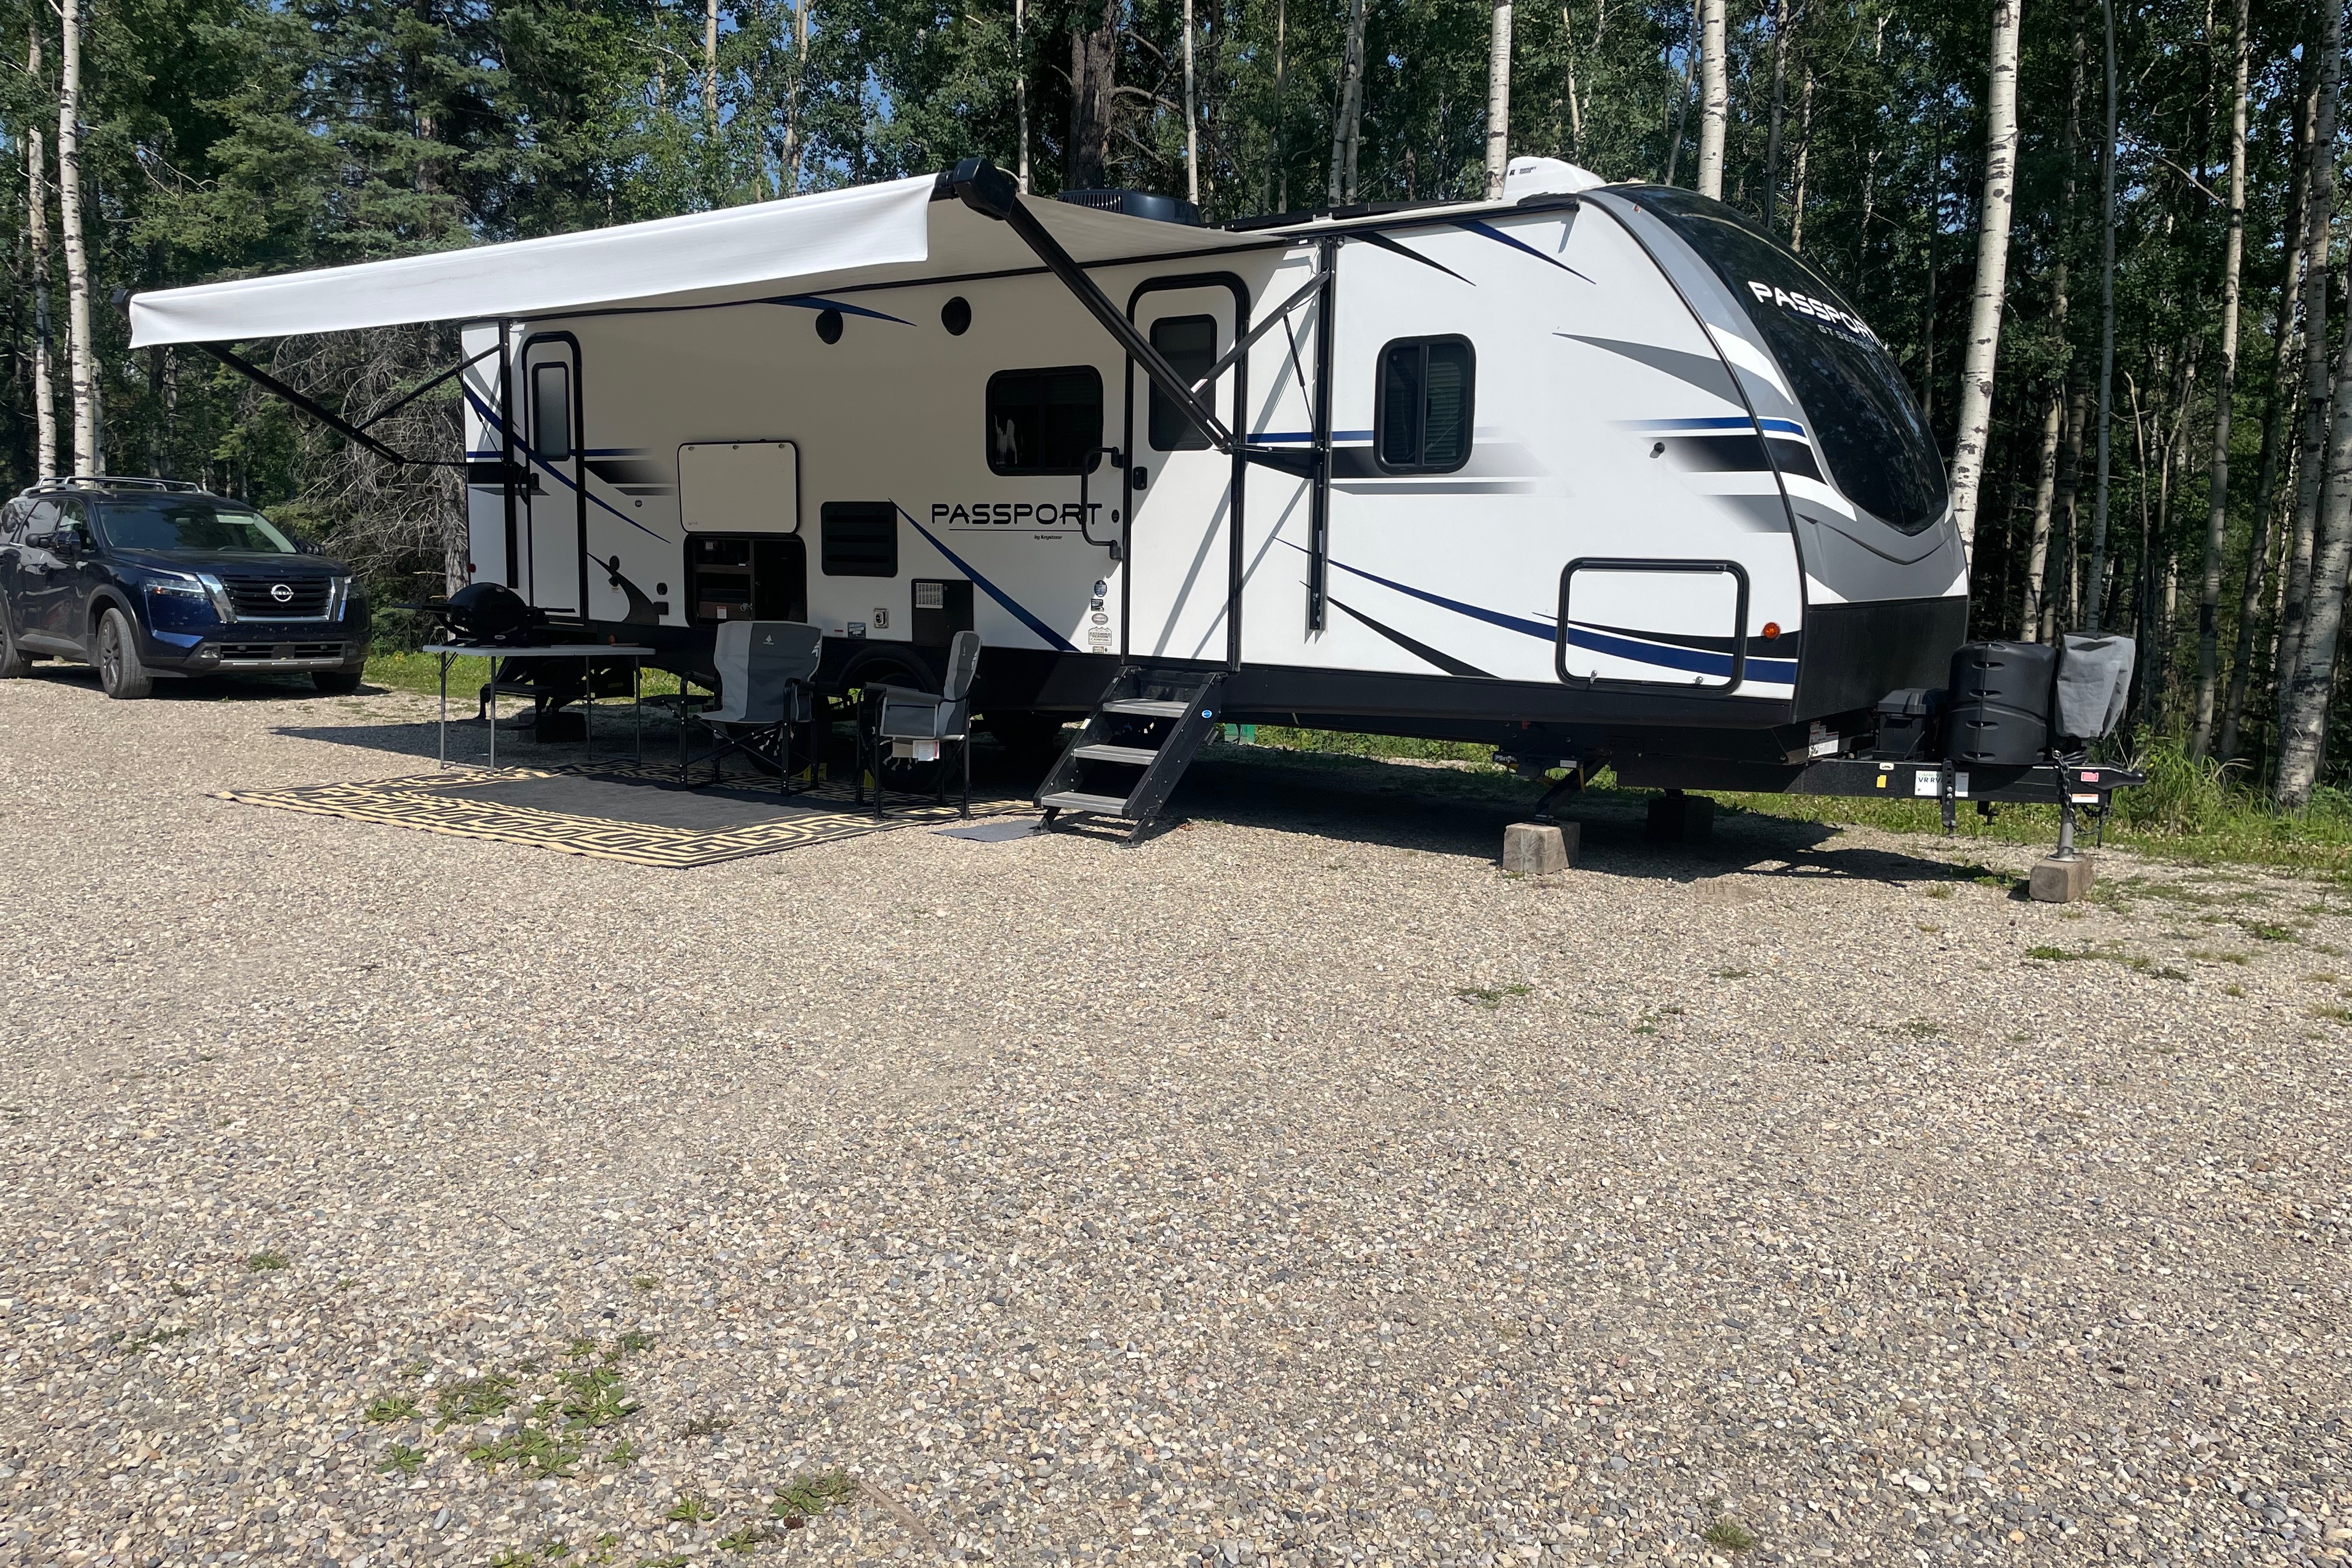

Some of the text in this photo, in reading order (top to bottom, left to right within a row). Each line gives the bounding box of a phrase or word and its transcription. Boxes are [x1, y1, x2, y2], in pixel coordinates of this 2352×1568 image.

[1748, 281, 1881, 347] PASSPORT
[1817, 324, 1873, 353] GT SERIES
[932, 503, 1102, 525] PASSPORT
